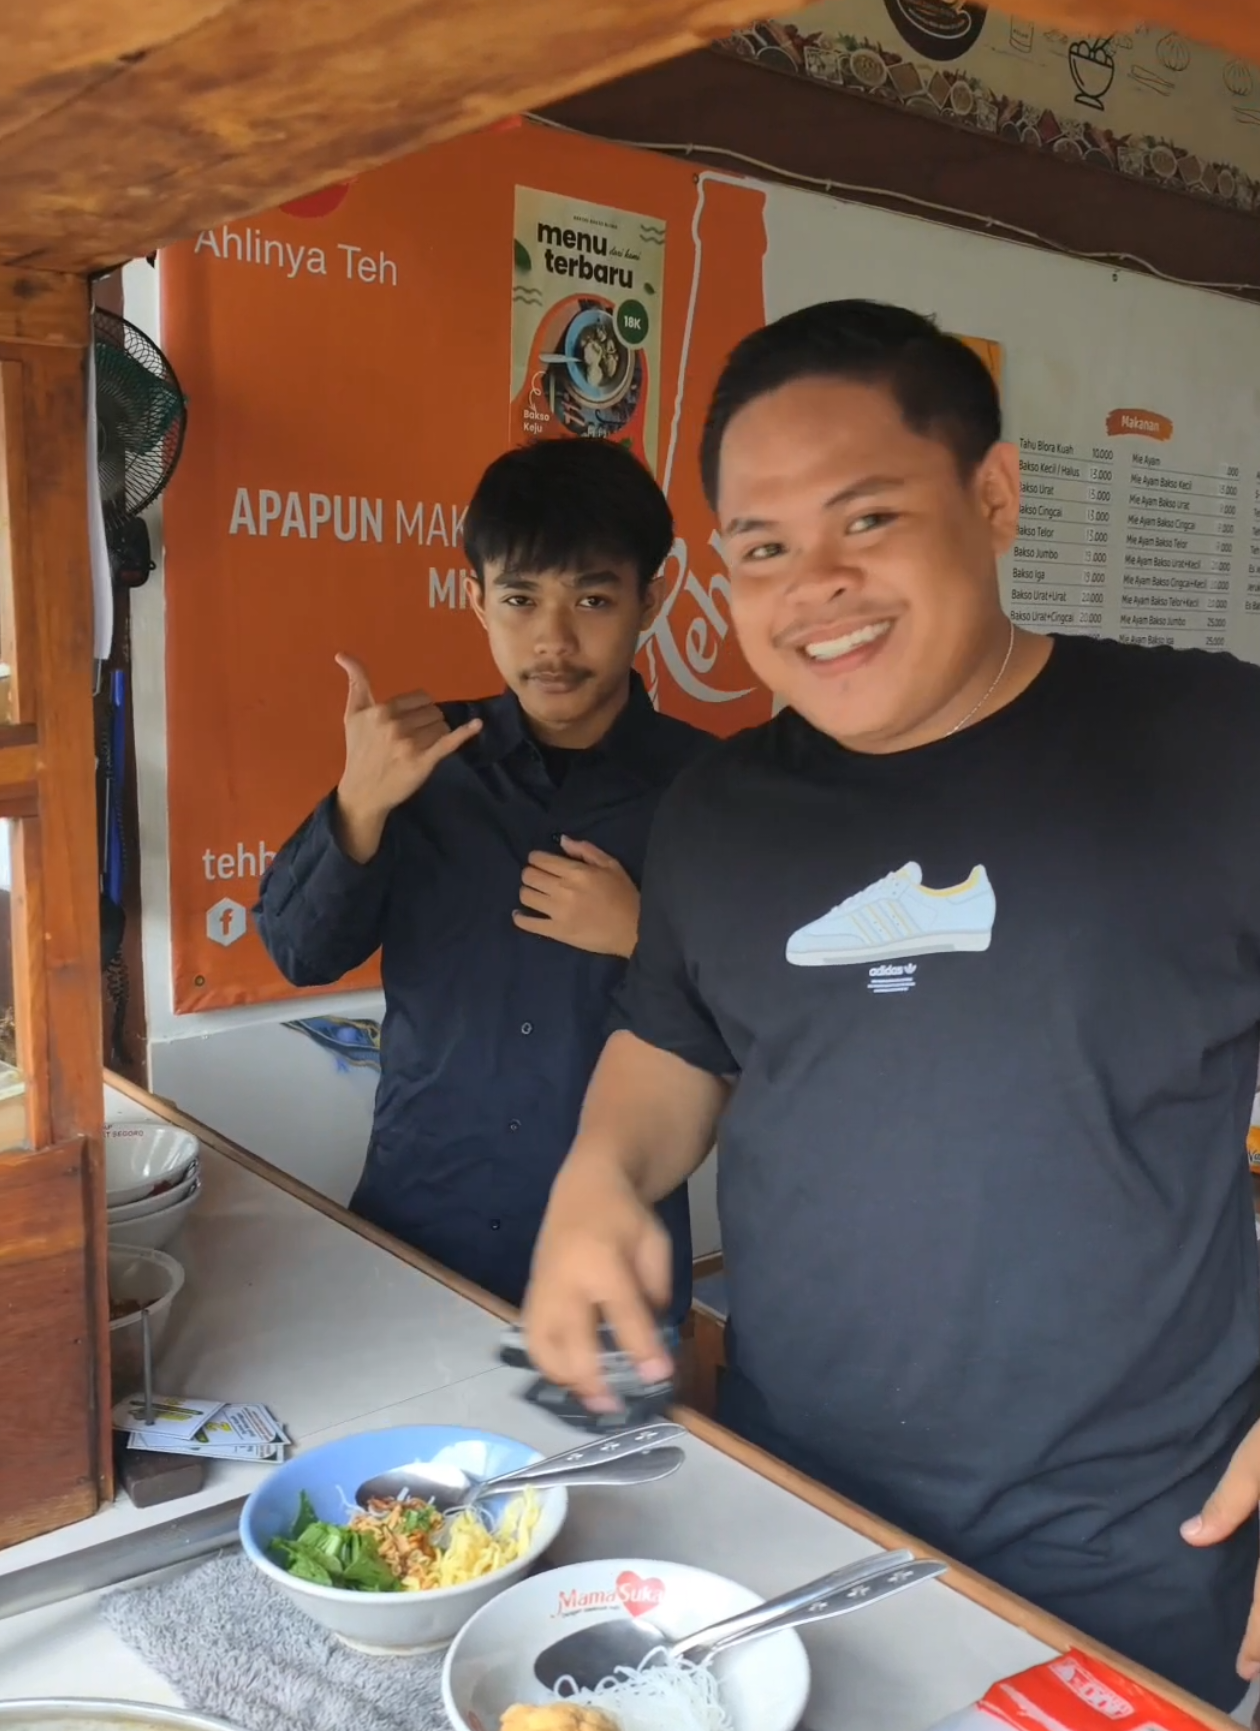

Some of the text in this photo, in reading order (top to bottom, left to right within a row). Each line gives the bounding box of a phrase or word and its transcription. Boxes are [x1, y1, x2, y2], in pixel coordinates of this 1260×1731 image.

[538, 222, 608, 257] menu
[195, 225, 397, 286] Ahlinya Teh
[545, 248, 633, 289] terbaru
[624, 316, 642, 330] 18K
[523, 409, 551, 421] Bakso
[524, 422, 543, 435] Keju
[1121, 415, 1160, 432] Makanan
[1020, 438, 1036, 450] Tahu
[1038, 441, 1056, 453] Blora
[1057, 443, 1074, 455] Kuah
[1132, 453, 1143, 464] Mie
[1144, 455, 1161, 466] Ayam
[1019, 460, 1039, 472] Bakso
[1040, 463, 1057, 474] Kecil
[1062, 465, 1080, 477] Halus
[1130, 474, 1142, 485] Mie
[1143, 476, 1159, 487] Ayam
[1160, 478, 1178, 489] Bakso
[1179, 480, 1193, 491] Kecil
[1040, 485, 1054, 496] Urat
[1129, 494, 1141, 505] Mie
[1142, 496, 1158, 508] Ayam
[1159, 498, 1176, 509] Bakso
[229, 487, 469, 548] APAPUN MAK
[1128, 515, 1139, 525] Mie
[1140, 517, 1156, 528] Ayam
[1157, 517, 1174, 528] Bakso
[1037, 526, 1055, 537] Telor
[1126, 535, 1138, 546] Mie
[1138, 536, 1154, 547] Ayam
[1156, 537, 1173, 548] Bakso
[1014, 547, 1035, 558] Bakso
[1036, 549, 1059, 560] Jumbo
[1125, 555, 1135, 566] Mie
[1136, 556, 1153, 567] Ayam
[1154, 557, 1171, 568] Bakso
[1013, 568, 1034, 579] Bakso
[1123, 575, 1134, 585] Mie
[1135, 577, 1151, 587] Ayam
[1152, 577, 1170, 587] Bakso
[429, 567, 476, 610] MI
[1012, 589, 1033, 600] Bakso
[1122, 595, 1133, 605] Mie
[1134, 596, 1150, 607] Ayam
[1151, 596, 1168, 606] Bakso
[1011, 611, 1031, 621] Bakso
[1120, 615, 1131, 625] Mie
[1132, 616, 1149, 627] Ayam
[1149, 616, 1167, 626] Bakso
[869, 964, 904, 977] adidas
